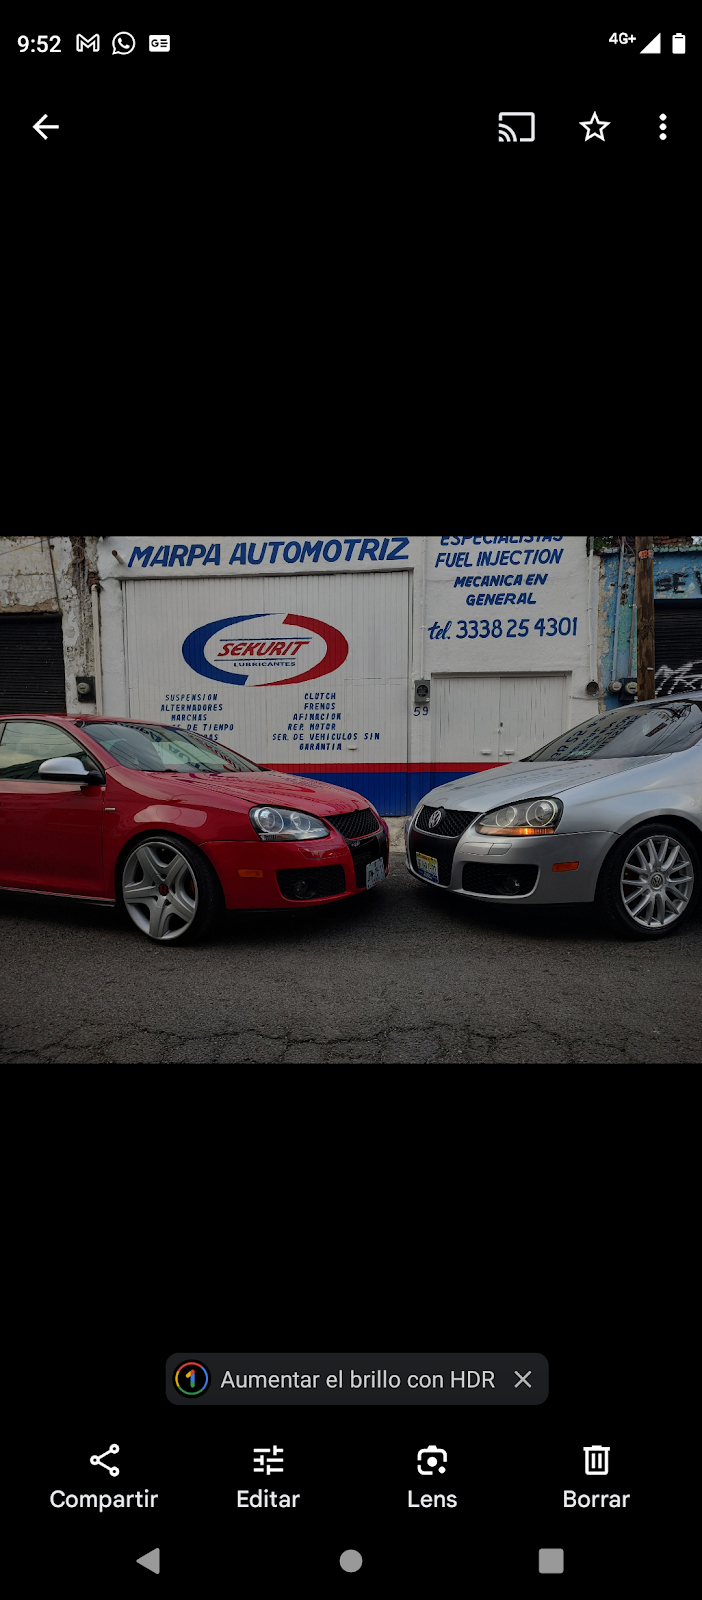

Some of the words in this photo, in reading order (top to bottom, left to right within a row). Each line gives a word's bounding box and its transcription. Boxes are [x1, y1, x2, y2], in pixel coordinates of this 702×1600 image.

[127, 543, 221, 568] MARPA
[229, 537, 410, 565] AUTOMOTRIZ
[435, 552, 473, 568] FUEL
[476, 548, 564, 567] INJECTION
[453, 574, 523, 588] MECANICA
[525, 573, 549, 586] EN
[466, 592, 537, 607] GENERAL
[427, 620, 453, 640] tel.
[456, 619, 503, 639] 3338
[506, 618, 531, 638] 25
[534, 617, 578, 637] 4301
[217, 641, 311, 657] SEKURIT
[165, 693, 218, 702] SUSPENSION
[304, 692, 336, 700] CLUTCH
[160, 703, 223, 712] ALTERNADORES
[304, 702, 336, 710] FRENOS
[413, 706, 429, 717] 59
[171, 713, 208, 722] MARCHAS
[292, 712, 342, 721] AFINACION
[186, 723, 198, 731] DE
[203, 723, 234, 731] TIEMPO
[287, 723, 304, 731] REP.
[309, 723, 336, 731] MOTOR
[292, 733, 304, 741] DE
[309, 733, 358, 741] VEHICULOS
[363, 732, 380, 741] SIN
[299, 743, 342, 751] GARANTIA
